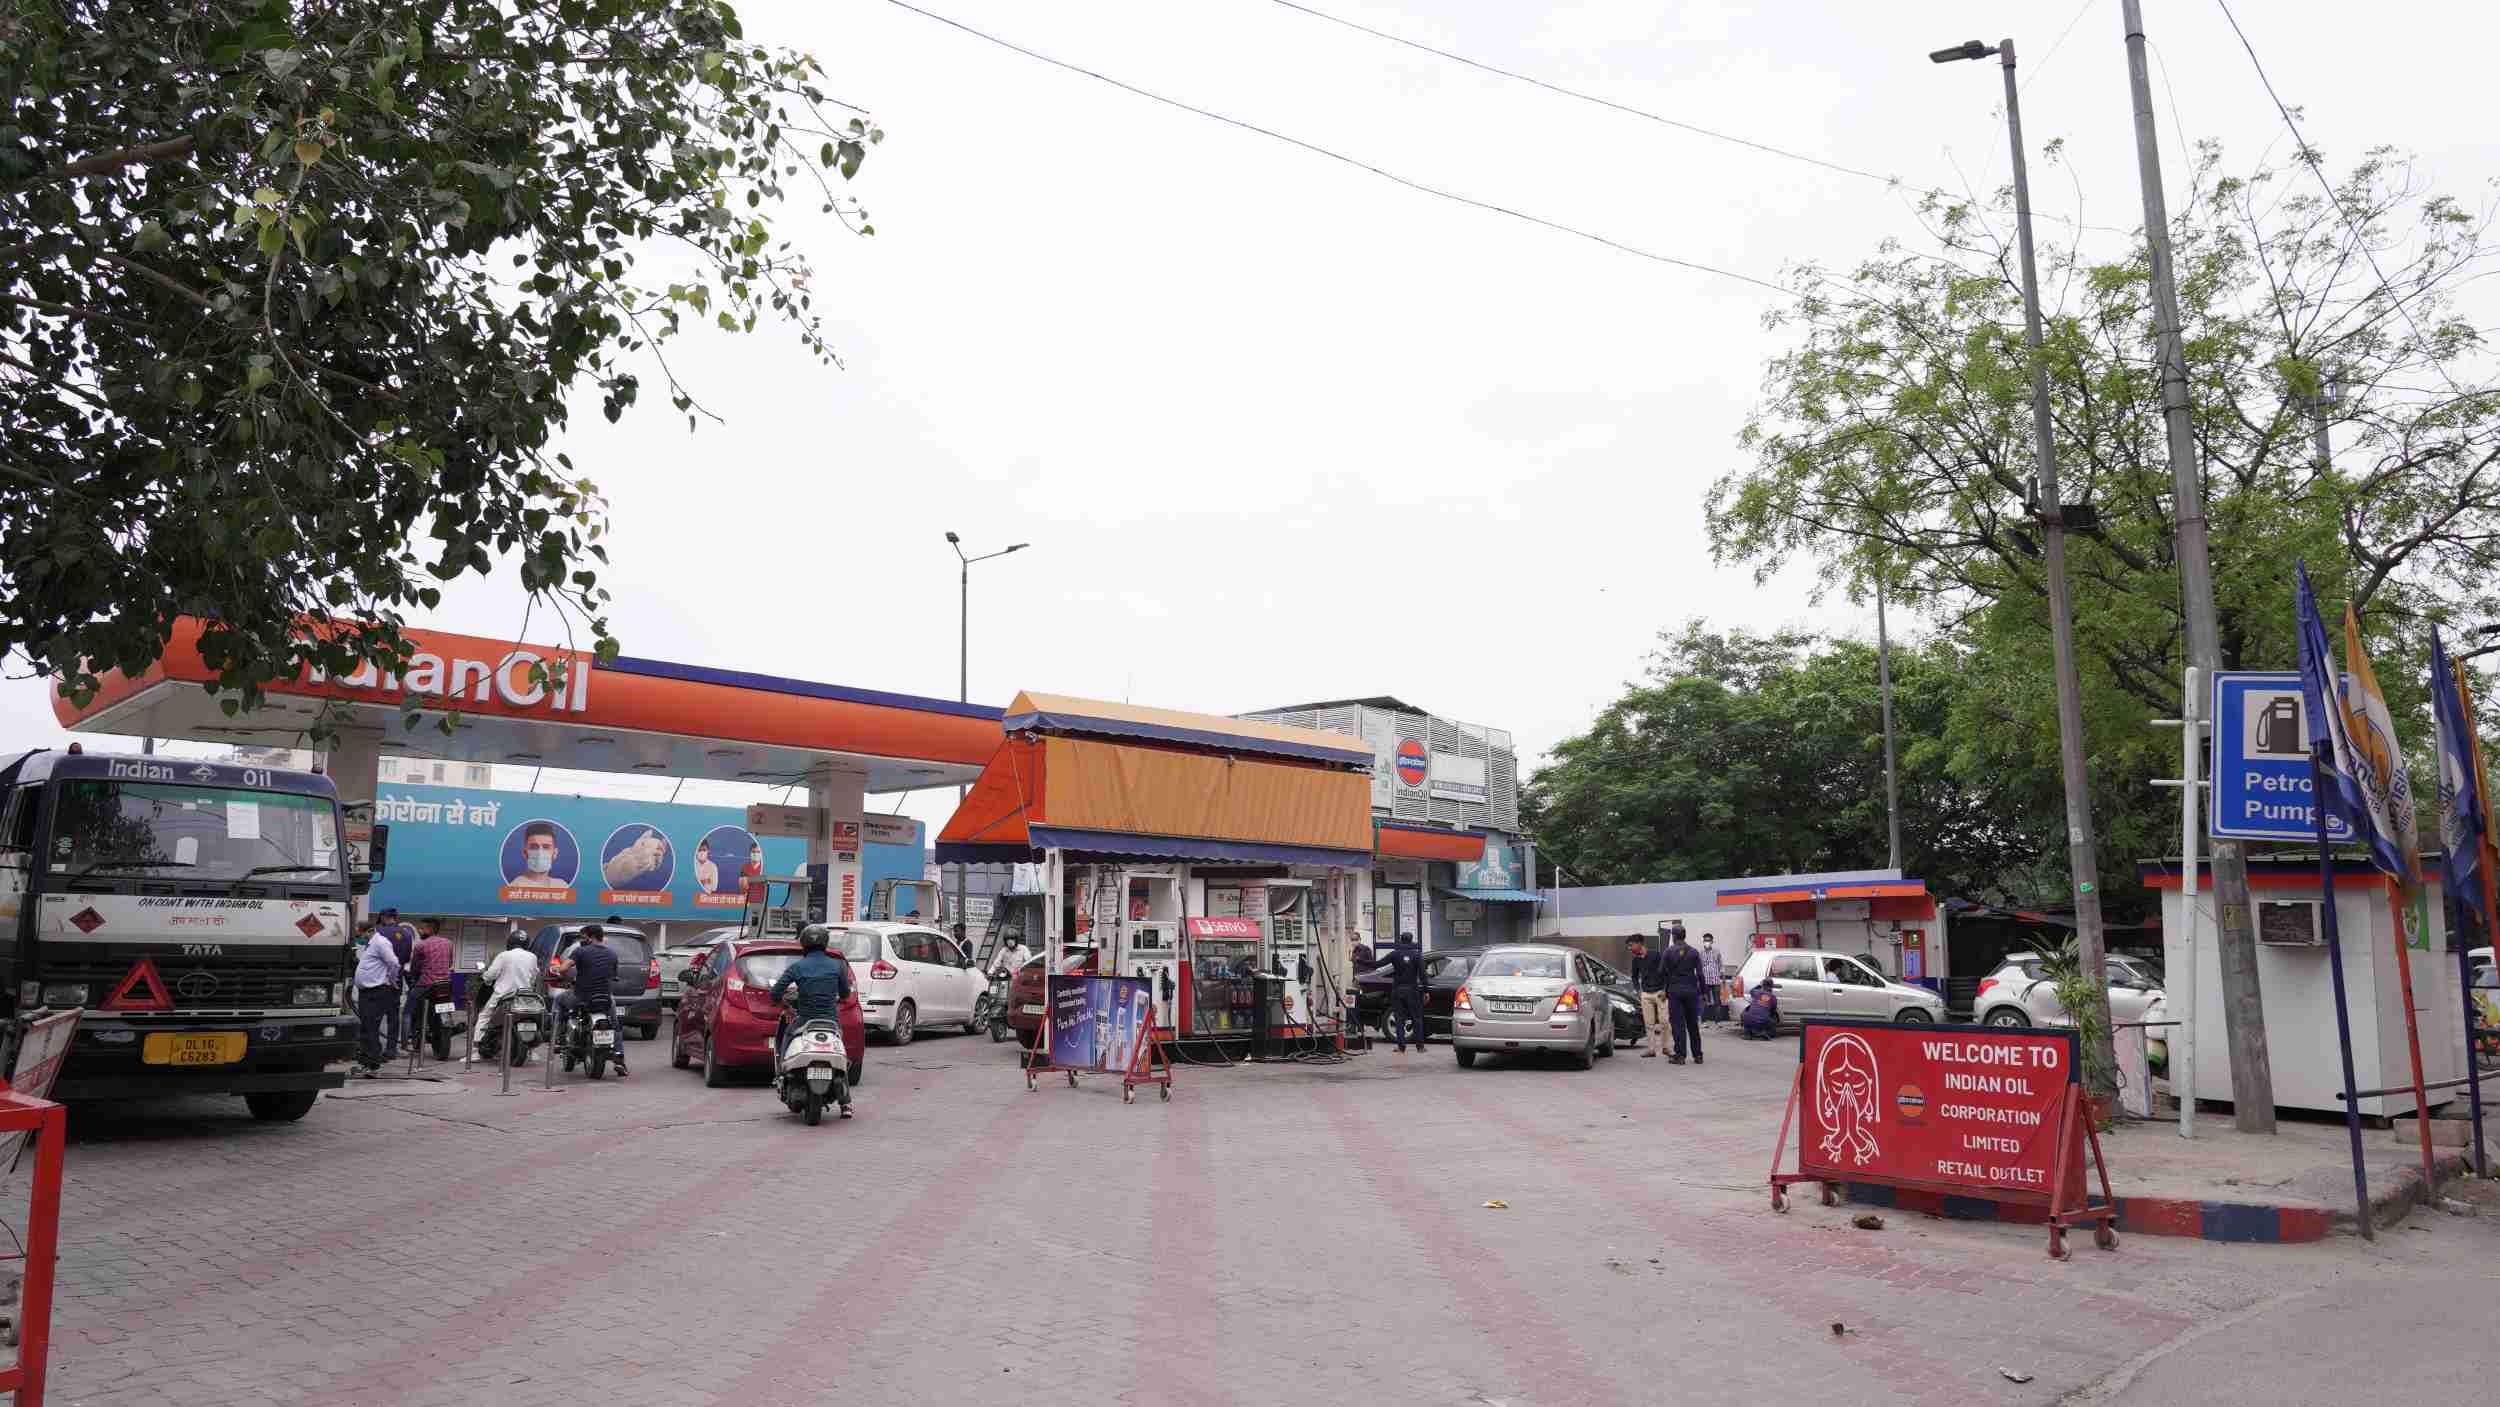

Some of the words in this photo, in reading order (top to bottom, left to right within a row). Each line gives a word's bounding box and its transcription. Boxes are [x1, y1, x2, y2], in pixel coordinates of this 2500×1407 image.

[289, 640, 589, 712] dianOil
[107, 760, 175, 780] Indian
[243, 769, 272, 787] Oil
[2245, 772, 2313, 792] Petro
[375, 794, 442, 823] कोरोना
[445, 798, 466, 825] से
[469, 800, 501, 827] बचें
[185, 898, 213, 909] WITH
[842, 873, 855, 922] EMIUM
[182, 944, 223, 955] TATA
[1922, 1041, 2024, 1066] WELCOME
[2028, 1046, 2058, 1069] TO
[1945, 1073, 2001, 1092] INDIAN
[2005, 1078, 2034, 1096] OIL
[1941, 1103, 2041, 1125] CORPORATION
[1963, 1134, 2020, 1153] LIMITED
[1937, 1160, 1987, 1179] RETAIL
[1990, 1166, 2045, 1183] OUTLET
